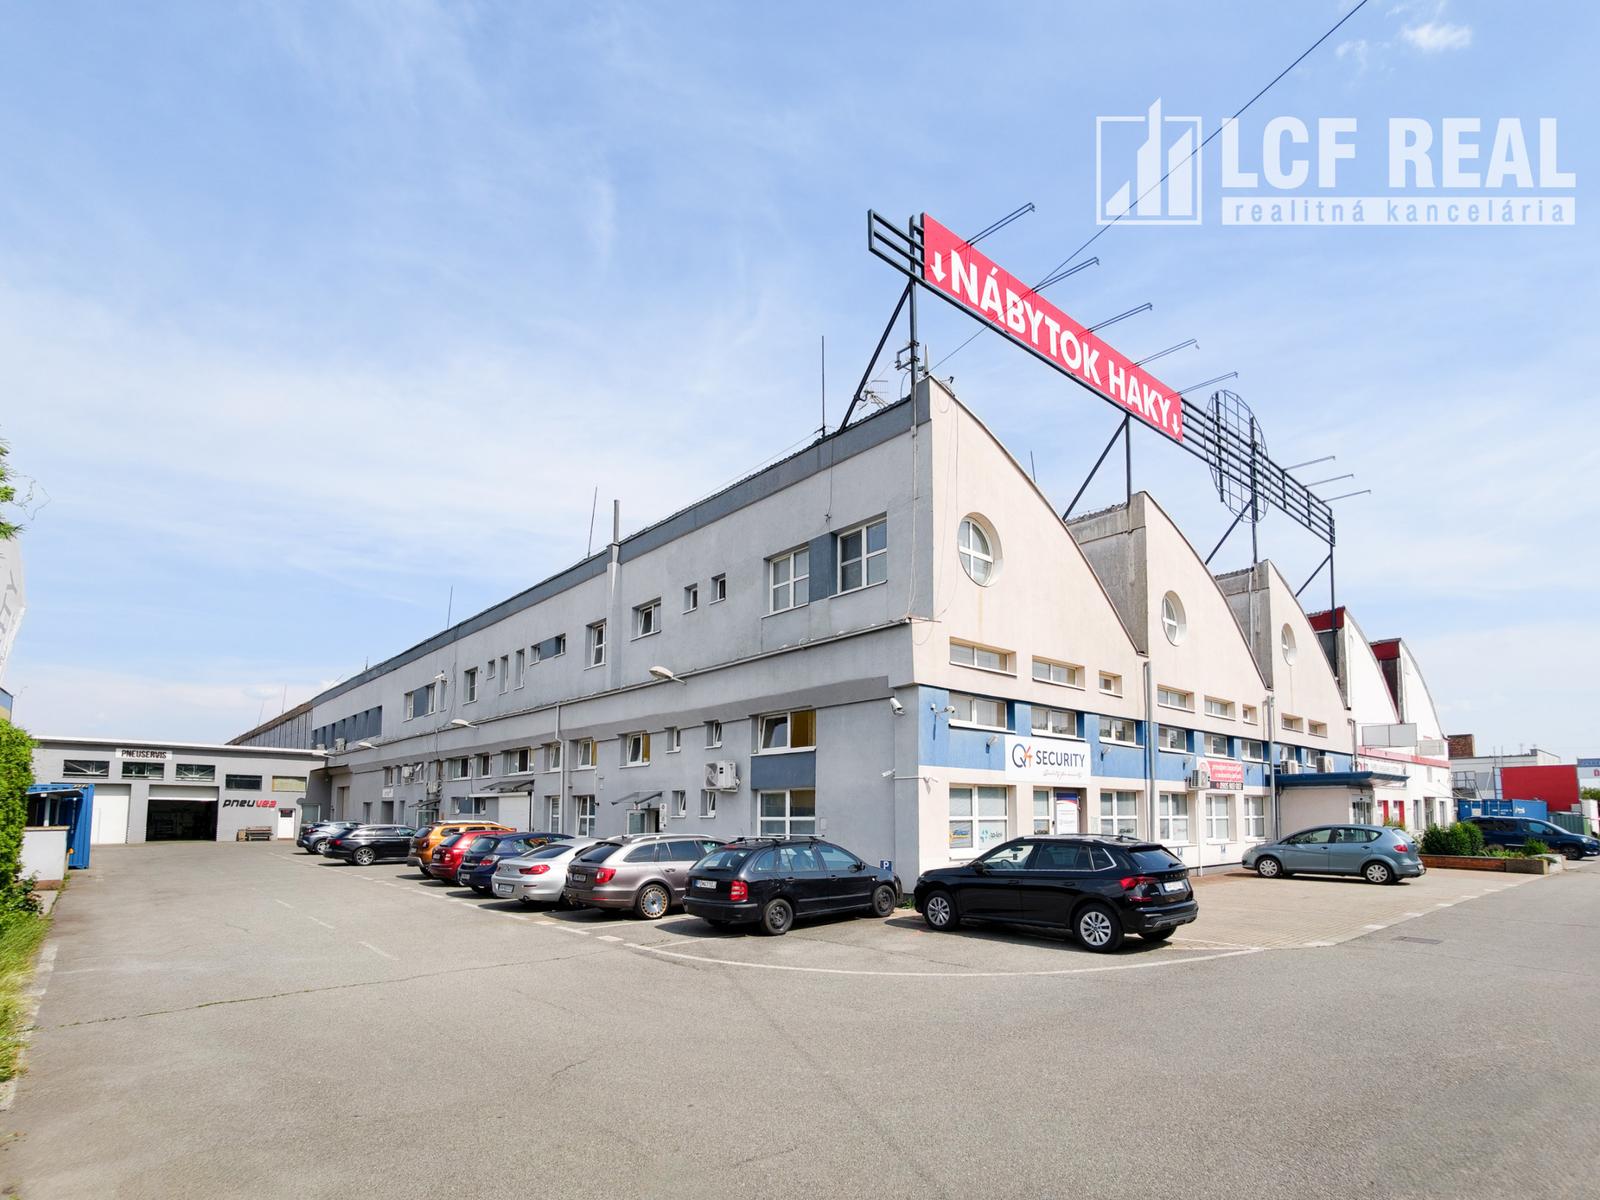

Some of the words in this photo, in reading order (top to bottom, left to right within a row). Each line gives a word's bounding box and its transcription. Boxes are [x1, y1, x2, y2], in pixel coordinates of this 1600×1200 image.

[950, 248, 1102, 386] NÁBYTOK
[1107, 360, 1171, 428] HAKY
[121, 749, 167, 759] PNEUSERVIS
[1035, 750, 1086, 768] SECURITY
[883, 861, 890, 870] P
